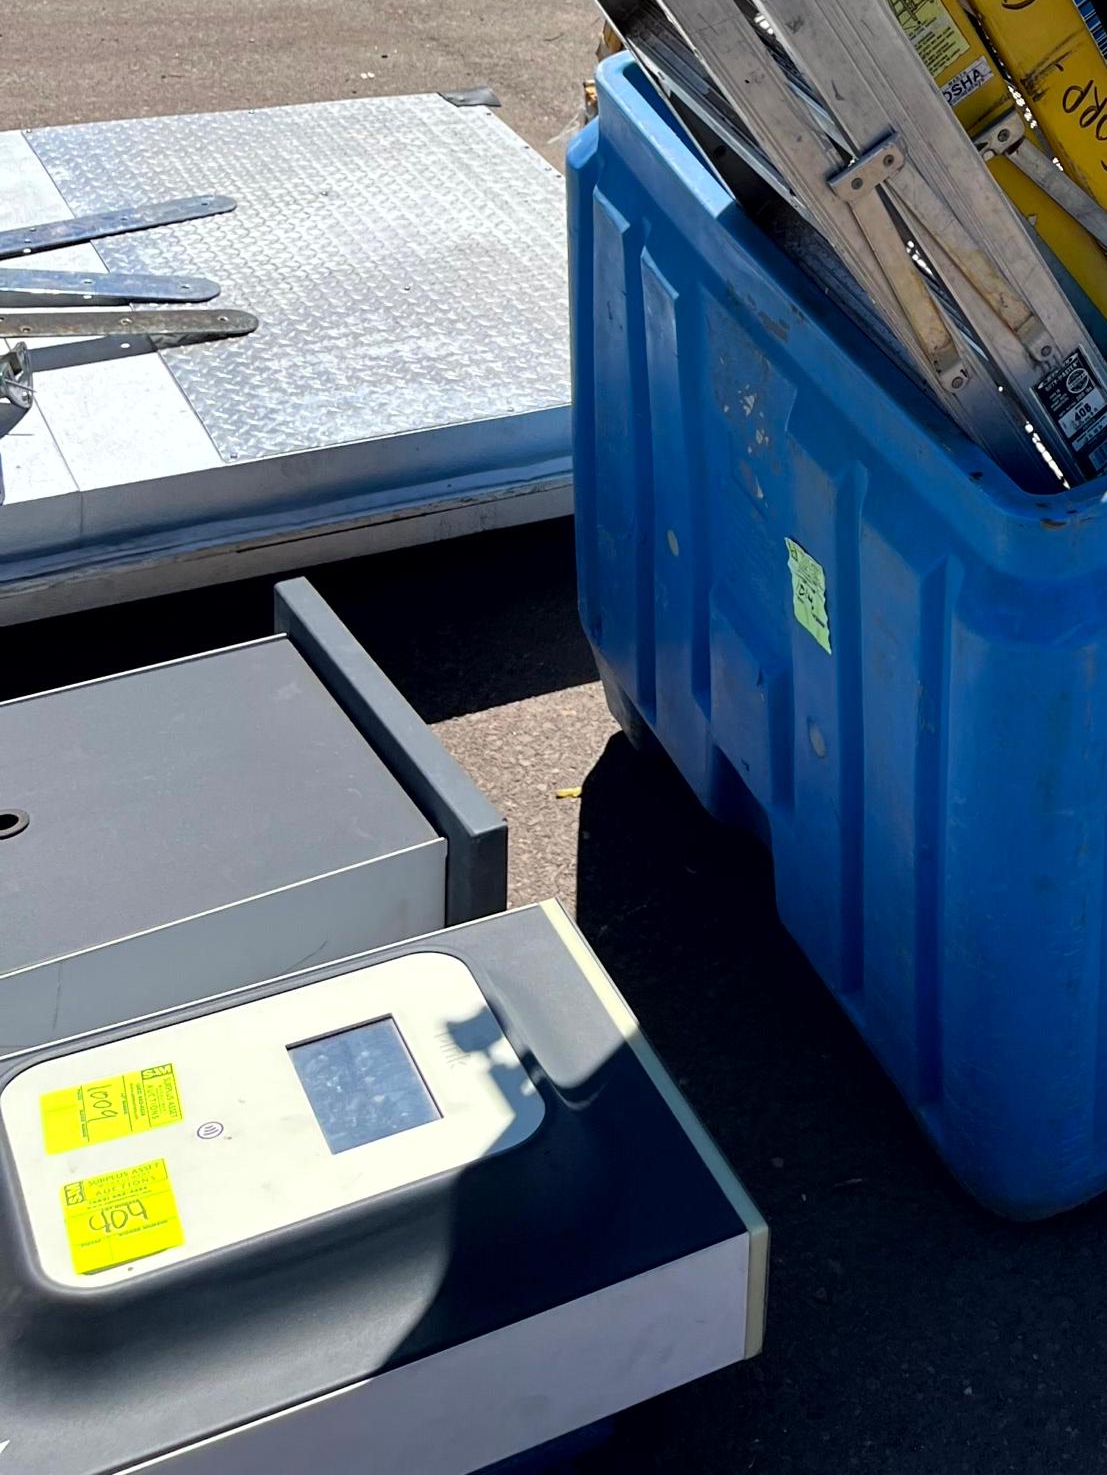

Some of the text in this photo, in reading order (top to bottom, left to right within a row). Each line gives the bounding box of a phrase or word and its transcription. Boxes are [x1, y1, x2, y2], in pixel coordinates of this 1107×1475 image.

[87, 1084, 118, 1123] 1009
[147, 1084, 160, 1120] AUCTIONS
[88, 1171, 129, 1187] SURPLUS
[131, 1162, 160, 1175] ASSET
[95, 1176, 156, 1197] AUCTIONS
[89, 1198, 148, 1233] 404
